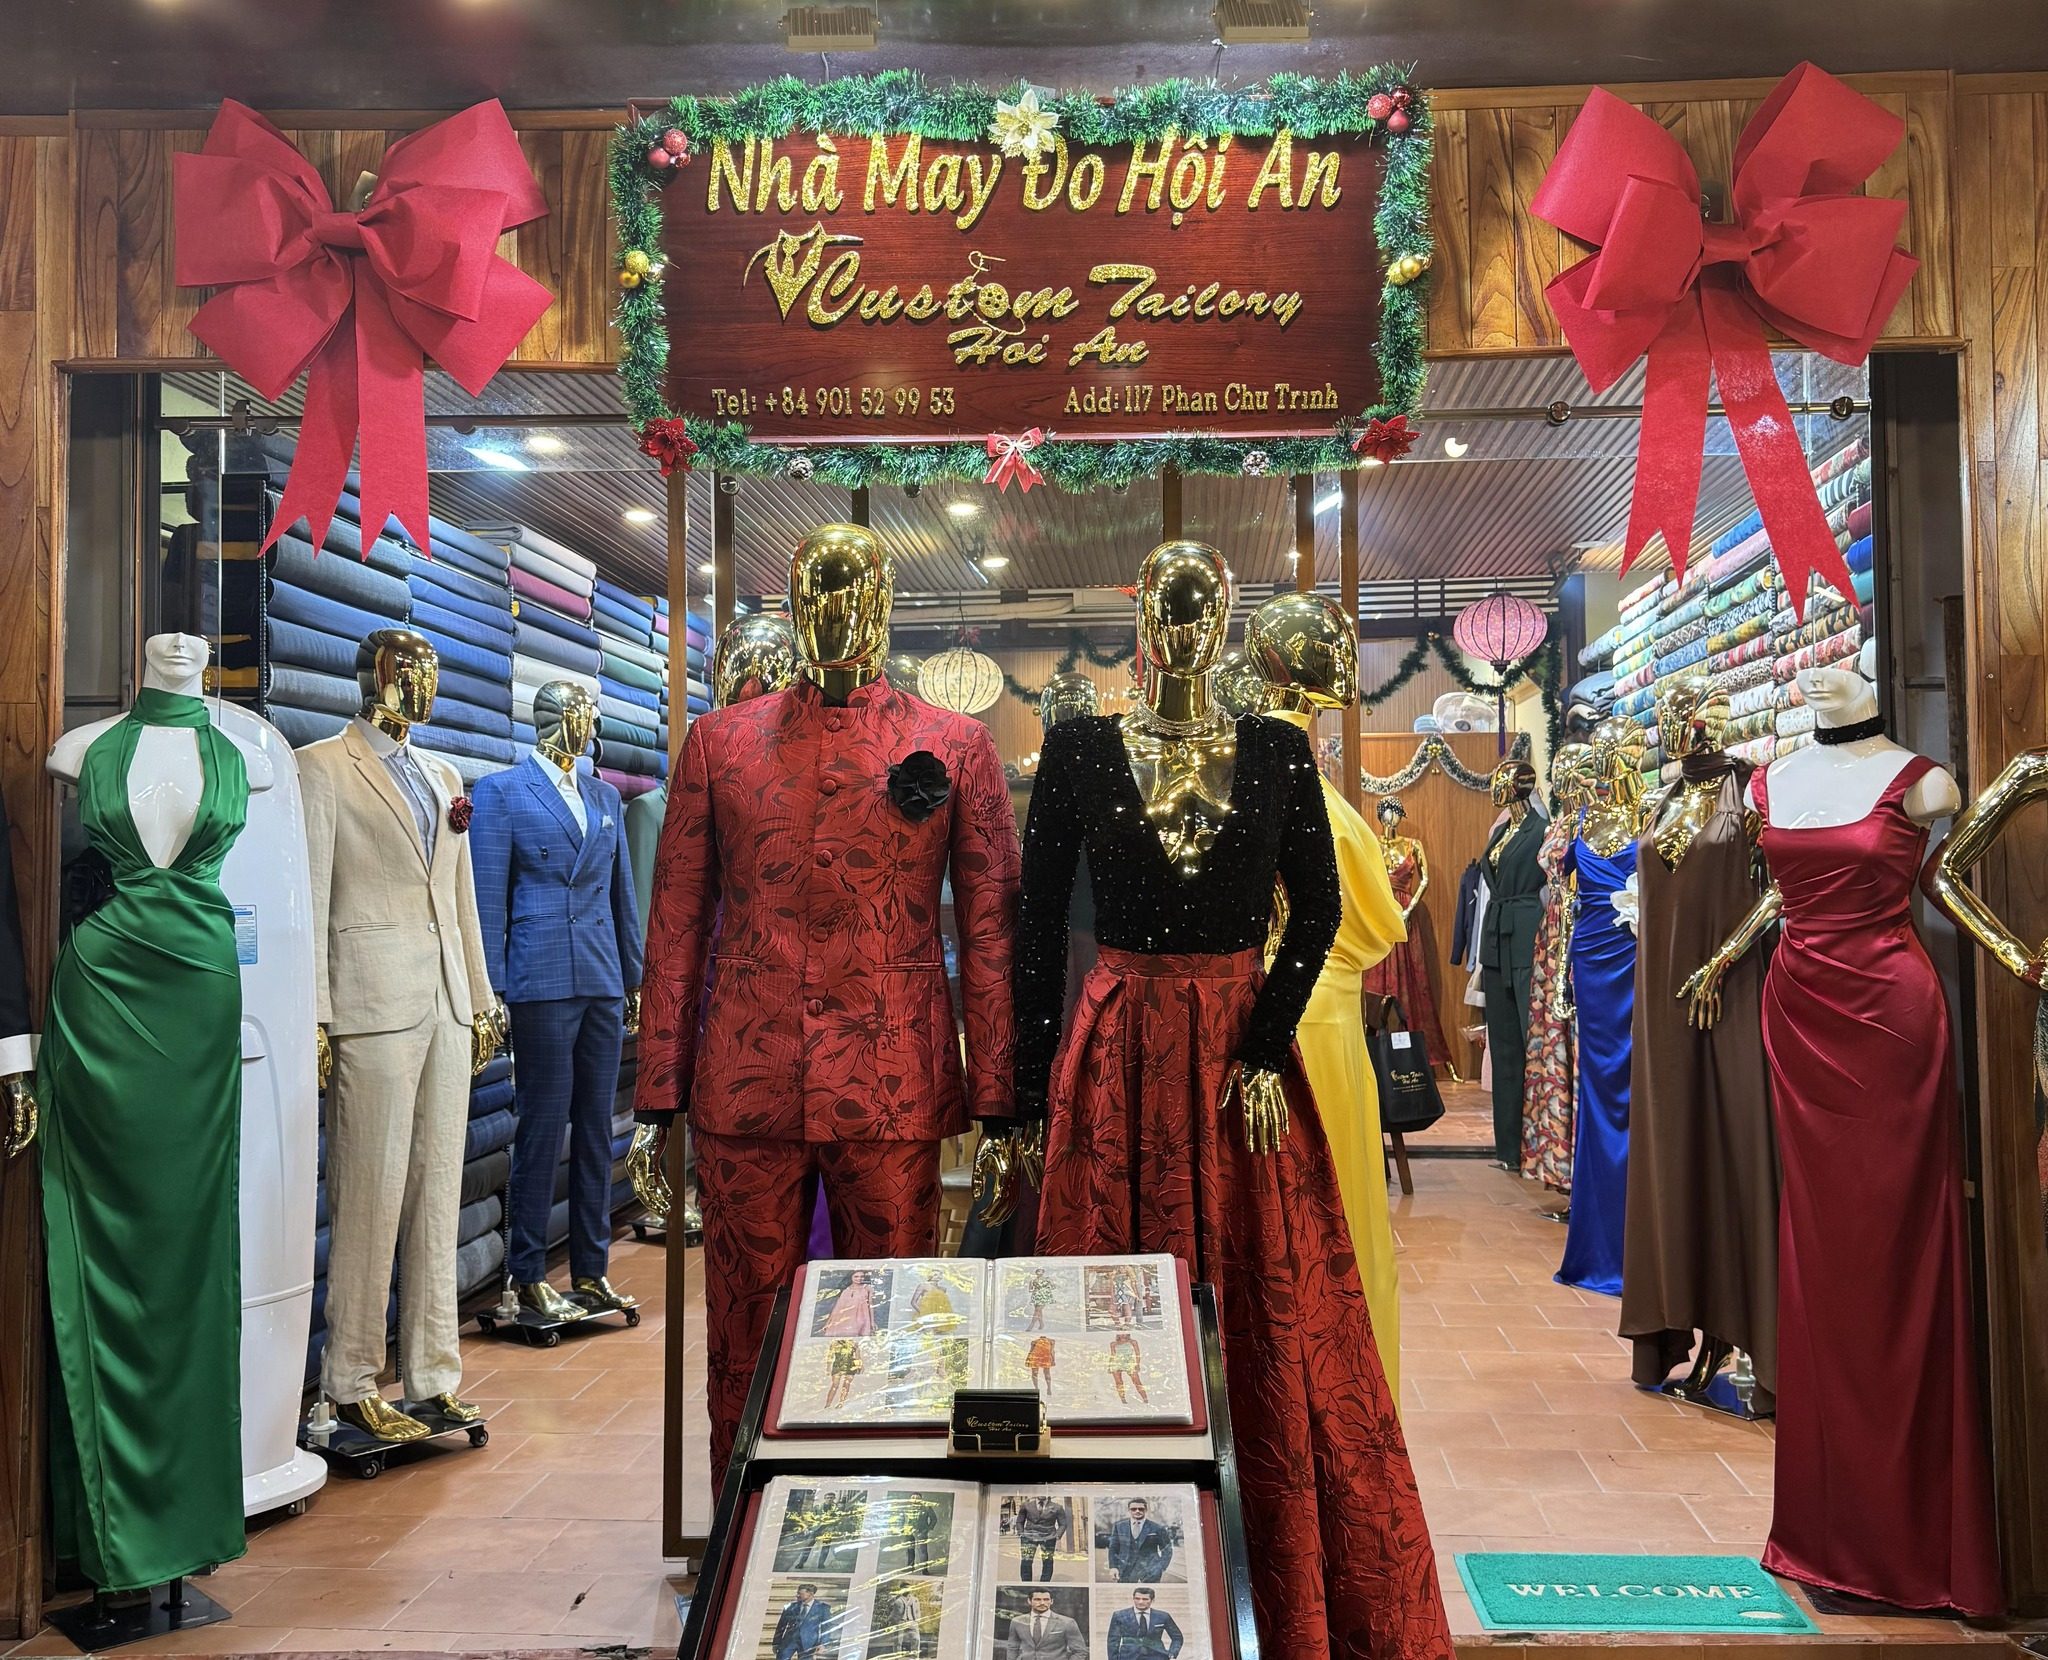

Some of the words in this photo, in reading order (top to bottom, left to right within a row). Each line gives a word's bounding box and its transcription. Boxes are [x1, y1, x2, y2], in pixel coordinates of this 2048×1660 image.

[707, 131, 844, 212] Nhà
[863, 131, 1001, 229] May
[1117, 125, 1235, 226] Hội
[1248, 128, 1342, 208] An
[807, 251, 1080, 325] Custom
[1089, 263, 1303, 327] Tailory
[947, 326, 1048, 365] Hoi
[1068, 325, 1150, 367] An
[711, 388, 757, 416] Tel:
[765, 386, 809, 416] +84
[815, 386, 852, 416] 901
[860, 387, 886, 416] 52
[895, 387, 921, 415] 99
[930, 387, 955, 415] 53
[1161, 384, 1218, 412] Phan
[1224, 383, 1269, 410] Chu
[1504, 1583, 1763, 1600] WELCOME
